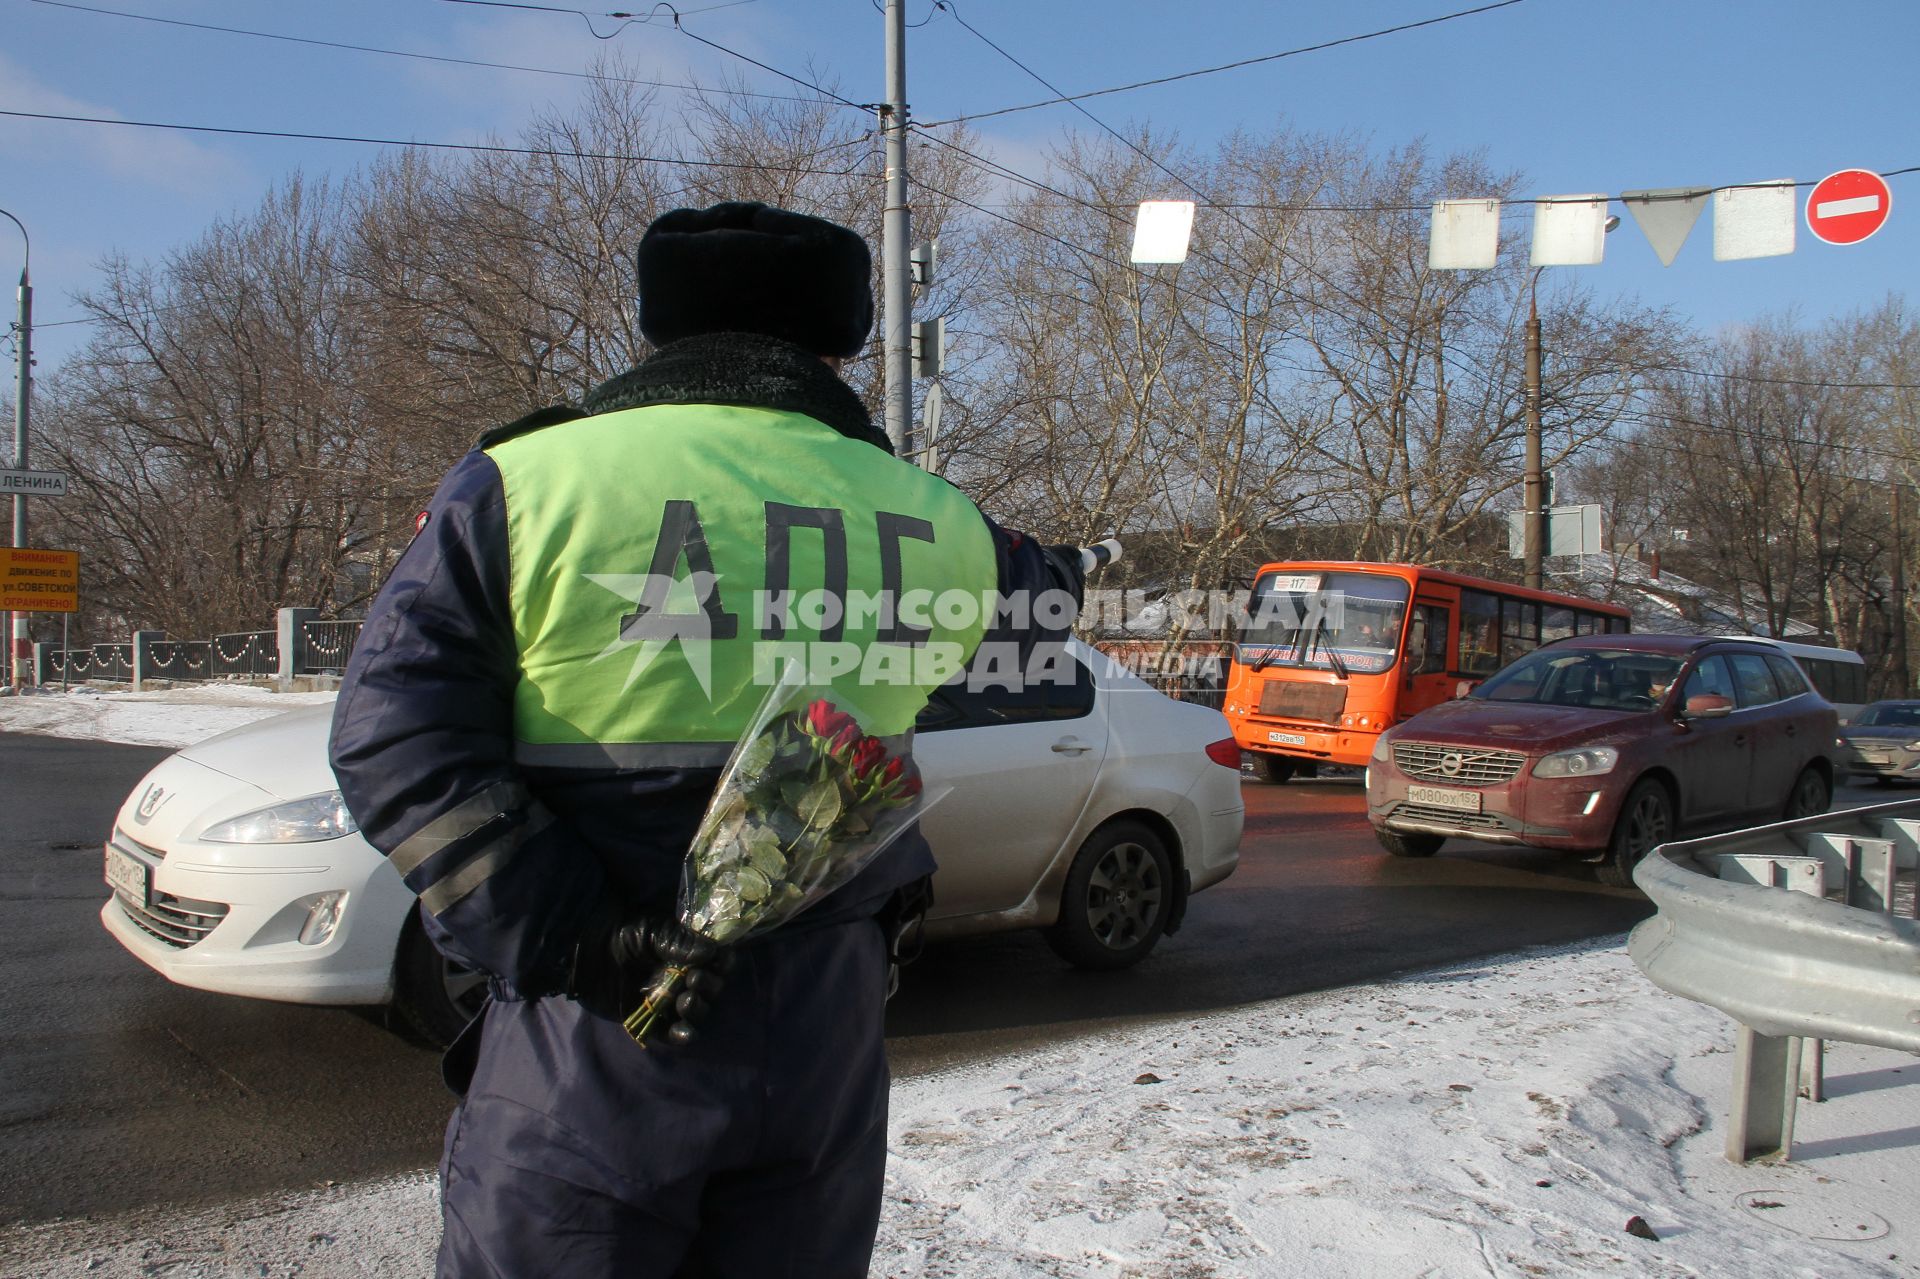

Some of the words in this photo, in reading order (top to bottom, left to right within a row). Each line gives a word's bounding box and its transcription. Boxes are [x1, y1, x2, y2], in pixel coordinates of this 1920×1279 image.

[2, 475, 63, 489] ЛЕНИНА
[11, 552, 68, 564] ВНИМАНИЕ!
[8, 567, 57, 578] ДВИЖЕНИЕ
[60, 569, 72, 578] ПО
[620, 499, 936, 649] ДПС
[1290, 578, 1306, 589] 117
[4, 598, 73, 609] ОГРАНИЧЕНО!
